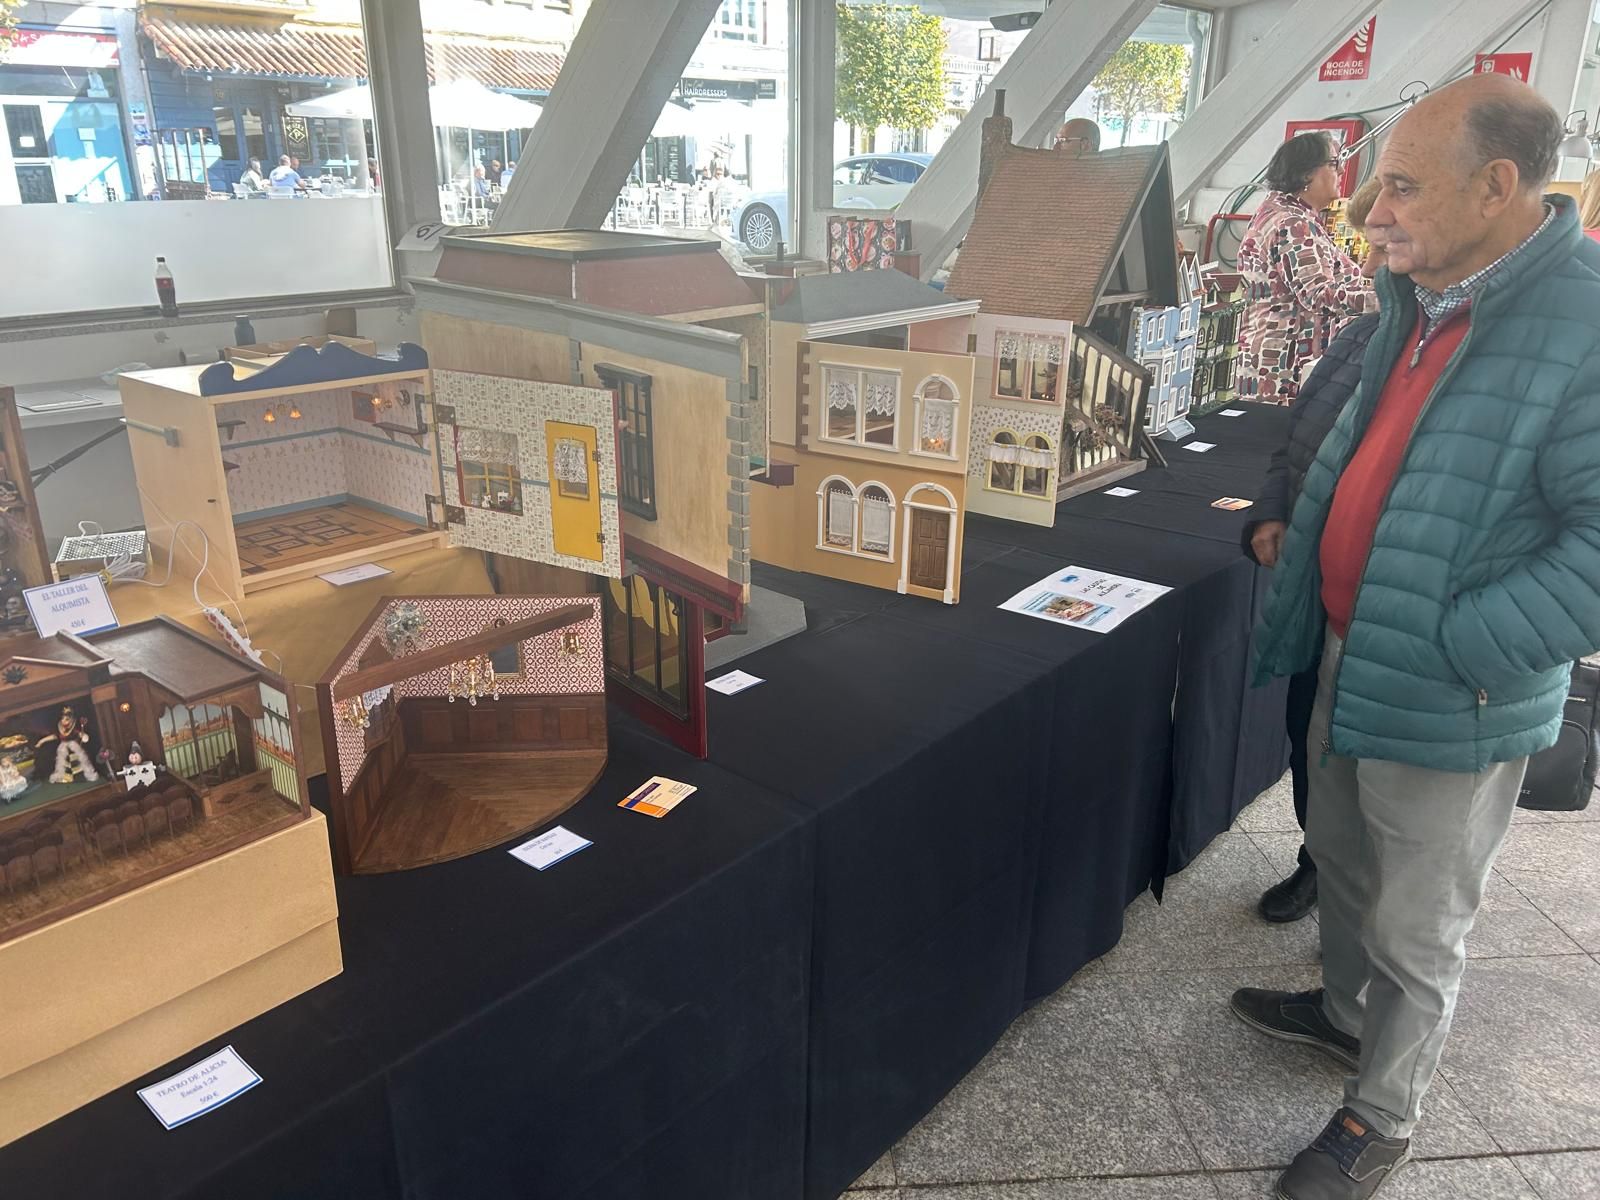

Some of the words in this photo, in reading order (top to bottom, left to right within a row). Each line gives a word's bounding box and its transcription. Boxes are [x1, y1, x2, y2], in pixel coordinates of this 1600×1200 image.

[1324, 67, 1363, 76] INCENDIO
[1326, 61, 1350, 69] BOCA
[684, 88, 728, 97] HAIRDRESSERS
[41, 592, 51, 601] EL
[52, 586, 76, 598] TALLER
[76, 583, 89, 592] DEL
[50, 596, 91, 612] ALQUIMISTA
[156, 1079, 188, 1097] TEATRO
[188, 1073, 200, 1084] DE
[201, 1059, 227, 1075] ALICIA
[180, 1083, 202, 1097] Escala
